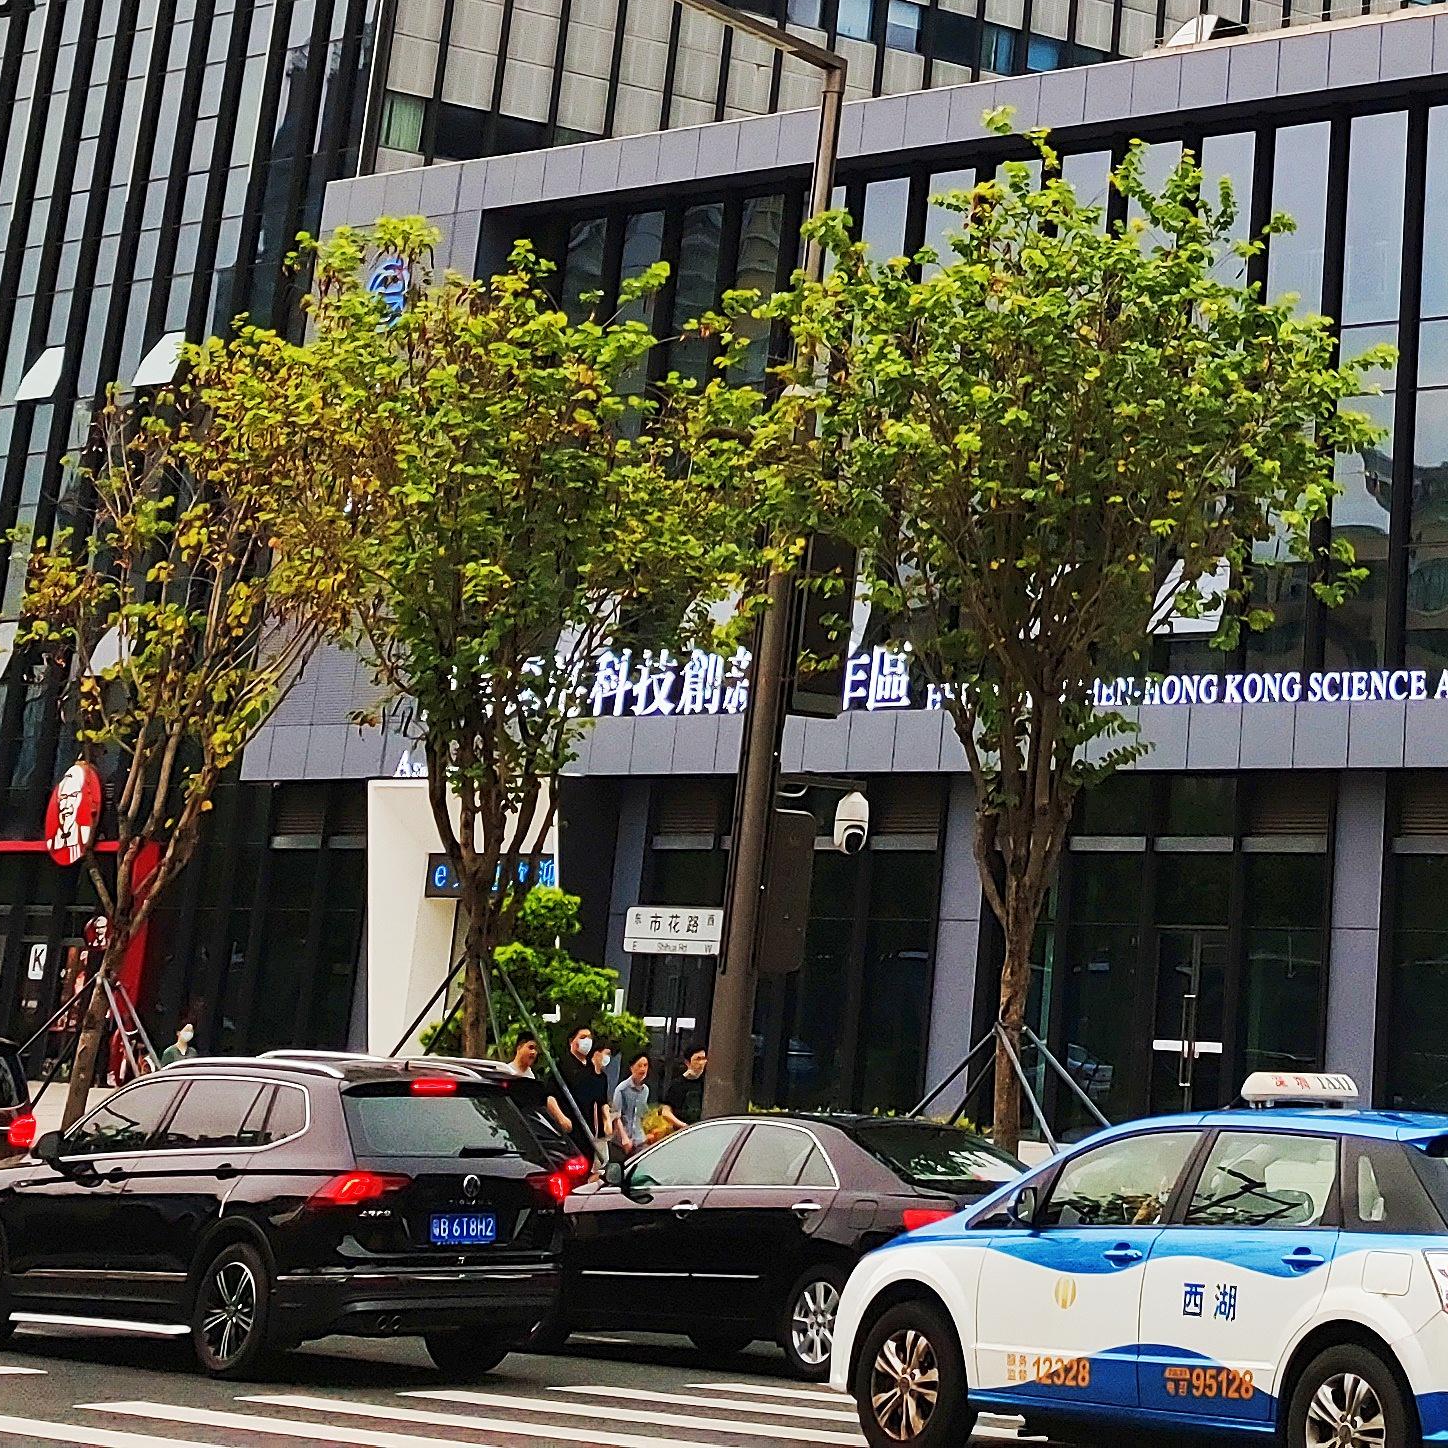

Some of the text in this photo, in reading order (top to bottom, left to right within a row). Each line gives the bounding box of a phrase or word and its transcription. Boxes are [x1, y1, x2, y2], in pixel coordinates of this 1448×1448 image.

[1224, 670, 1302, 704] KONG
[1307, 669, 1426, 703] SCIENCE
[649, 912, 700, 934] 市花路
[1183, 1282, 1238, 1322] 西湖
[1033, 1355, 1091, 1388] 12328
[1192, 1367, 1255, 1400] 95128
